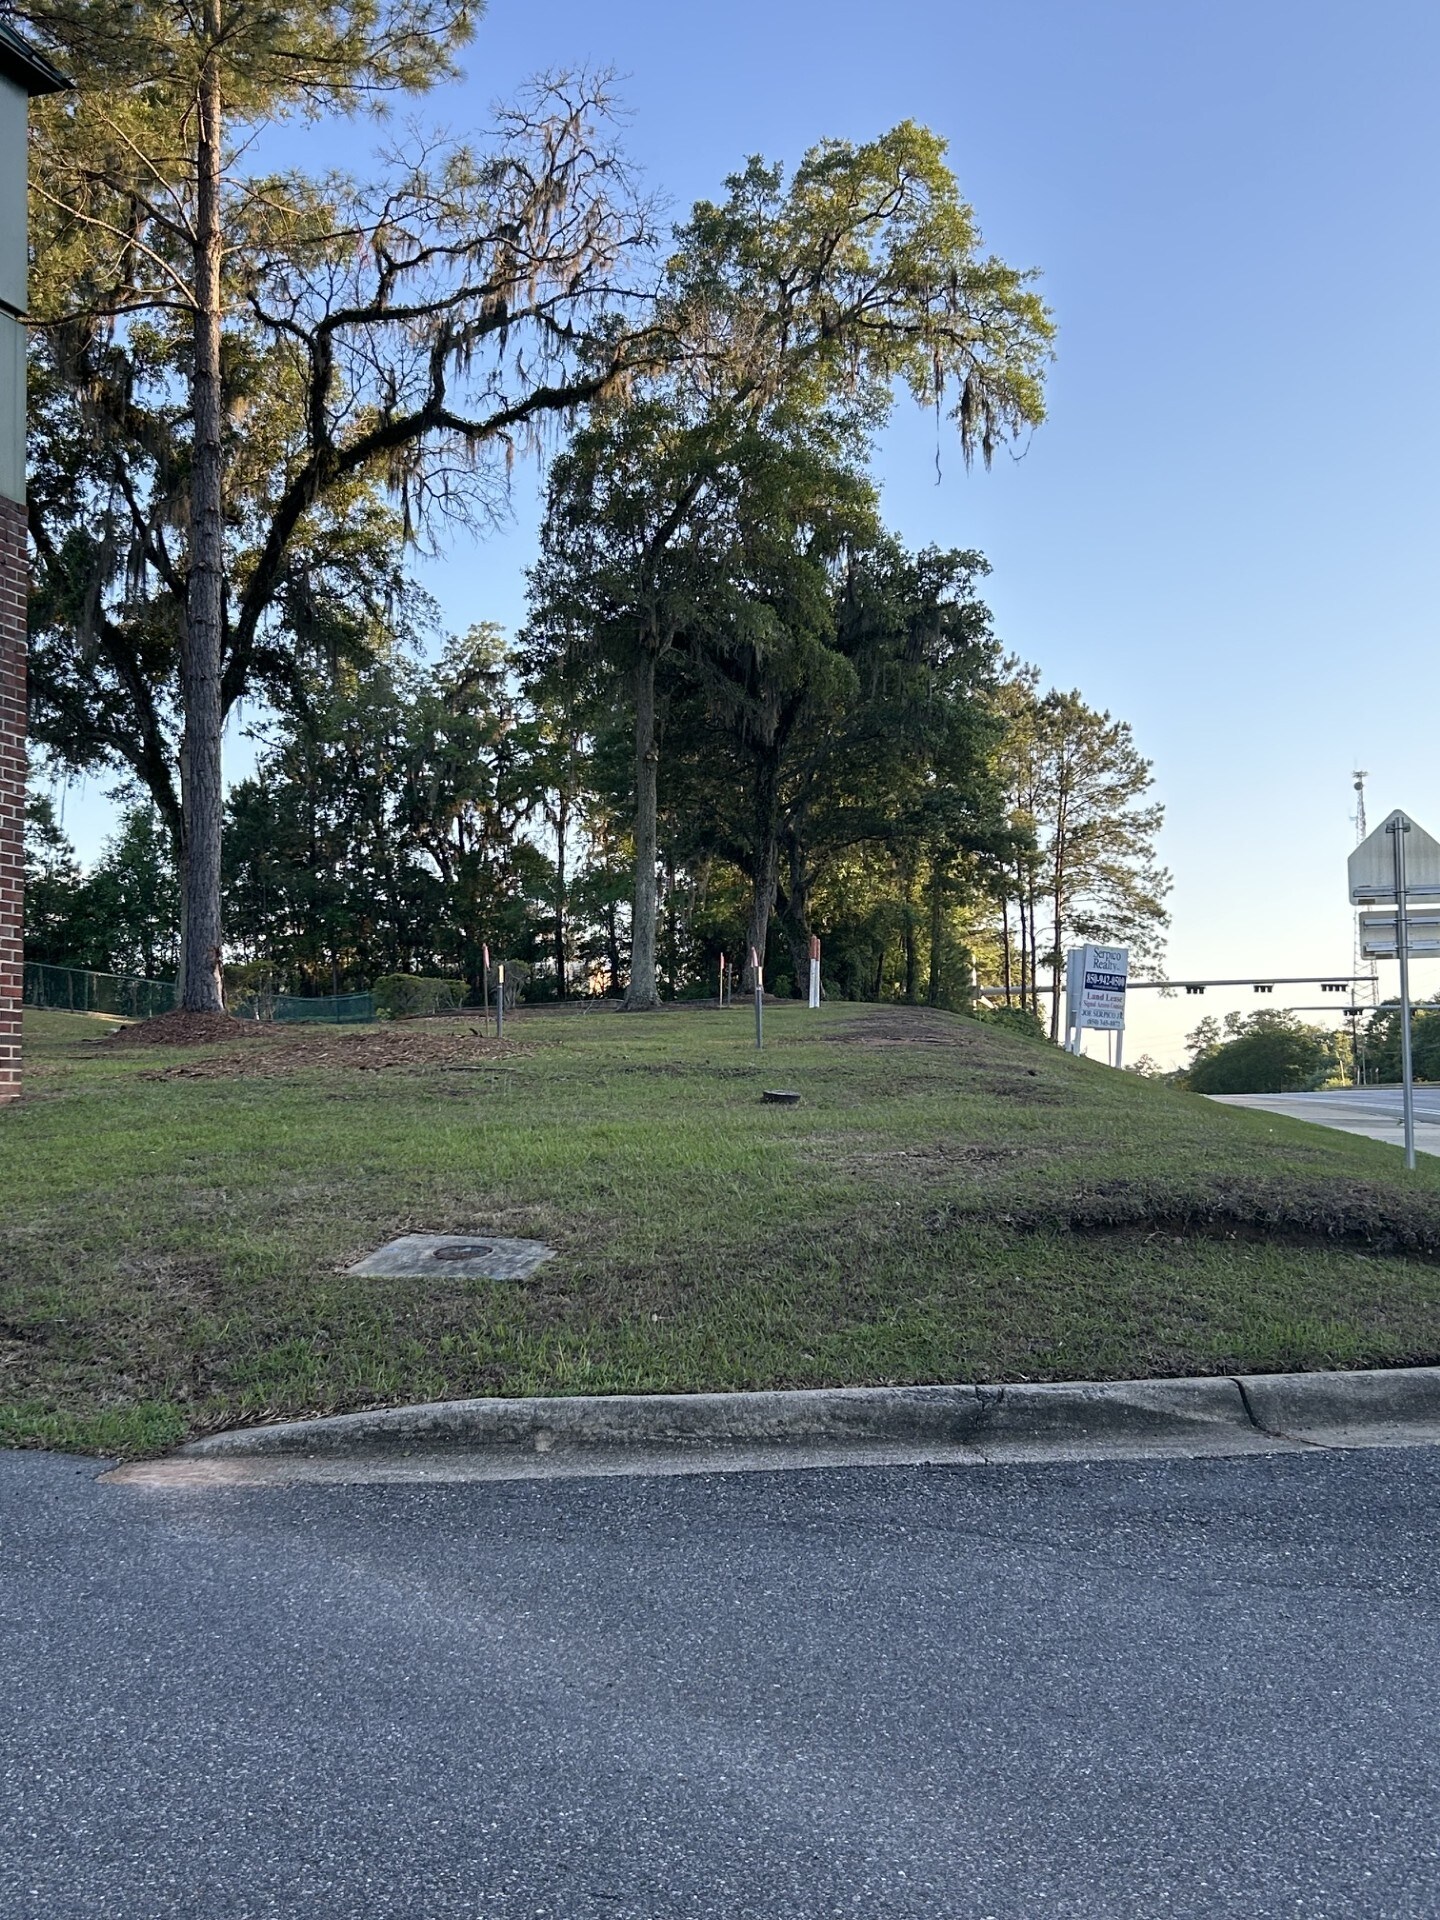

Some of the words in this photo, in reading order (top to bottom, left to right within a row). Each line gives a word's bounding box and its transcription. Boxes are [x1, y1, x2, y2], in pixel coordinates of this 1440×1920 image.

[1093, 947, 1121, 961] Serpico
[1093, 958, 1117, 973] Realty
[1087, 992, 1104, 1000] Land
[1106, 994, 1123, 1002] Lease
[1081, 1009, 1092, 1017] JOE
[1093, 1011, 1116, 1019] SERPICO
